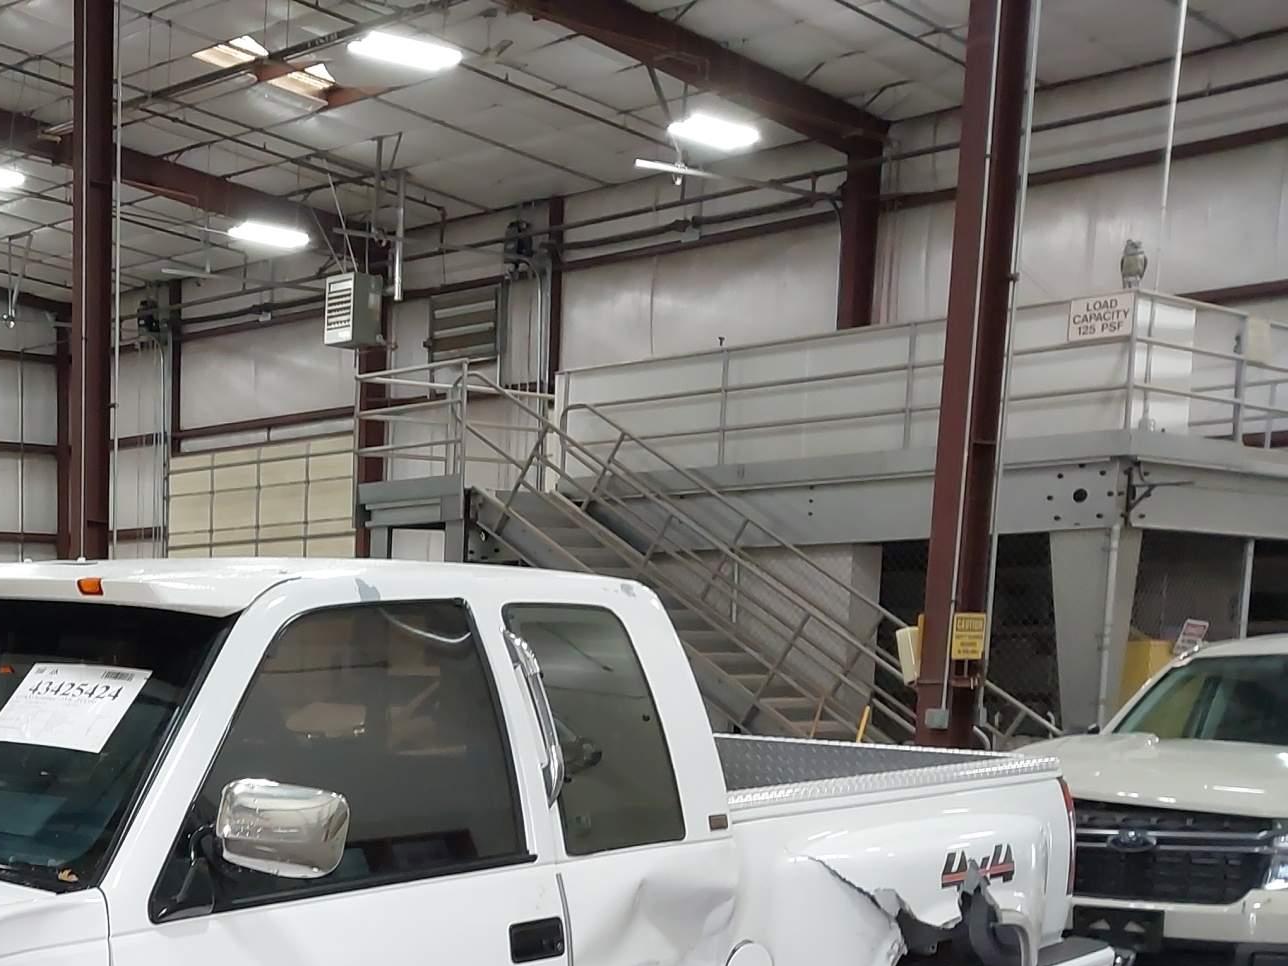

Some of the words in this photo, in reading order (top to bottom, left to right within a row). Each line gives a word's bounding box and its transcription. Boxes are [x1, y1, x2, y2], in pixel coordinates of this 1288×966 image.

[1086, 298, 1118, 312] LOAD
[1072, 307, 1130, 325] CAPACITY
[1078, 324, 1096, 336] 125
[1101, 320, 1124, 333] PSF
[29, 679, 124, 701] 43425424
